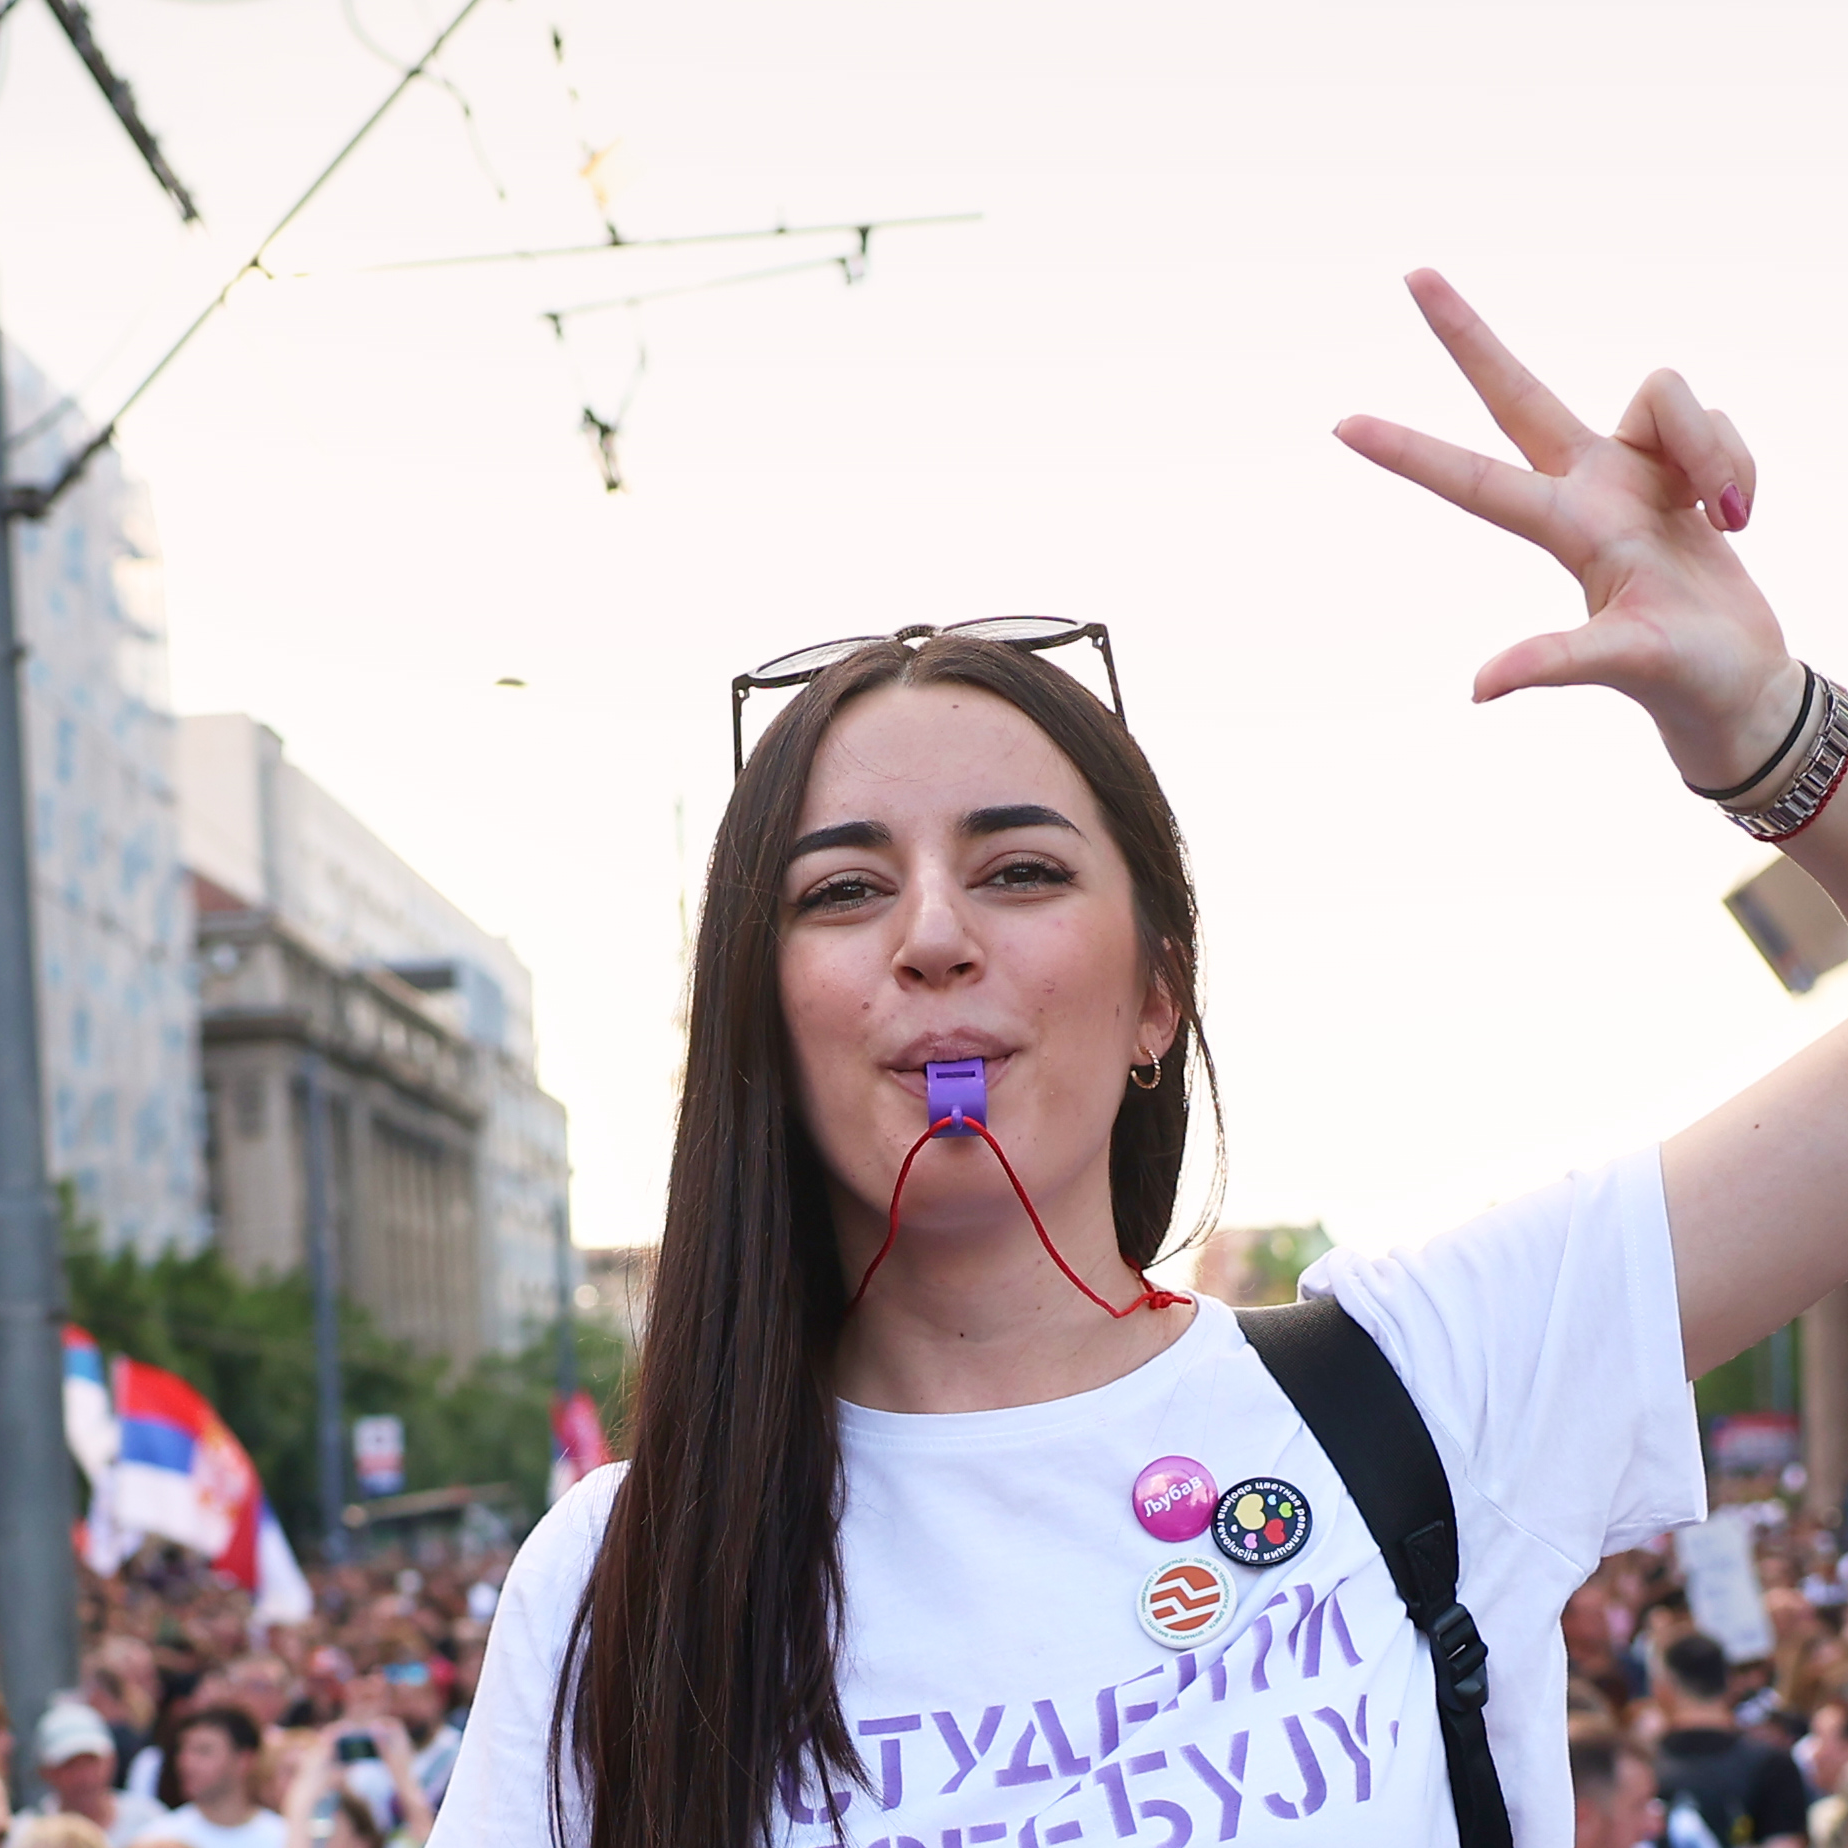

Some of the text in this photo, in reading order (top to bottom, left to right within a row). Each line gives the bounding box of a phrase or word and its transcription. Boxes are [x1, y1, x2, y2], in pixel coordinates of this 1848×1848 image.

[1143, 1475, 1203, 1518] Љубав
[1216, 1484, 1259, 1561] obojena revolucija
[1255, 1482, 1306, 1560] цветная революция
